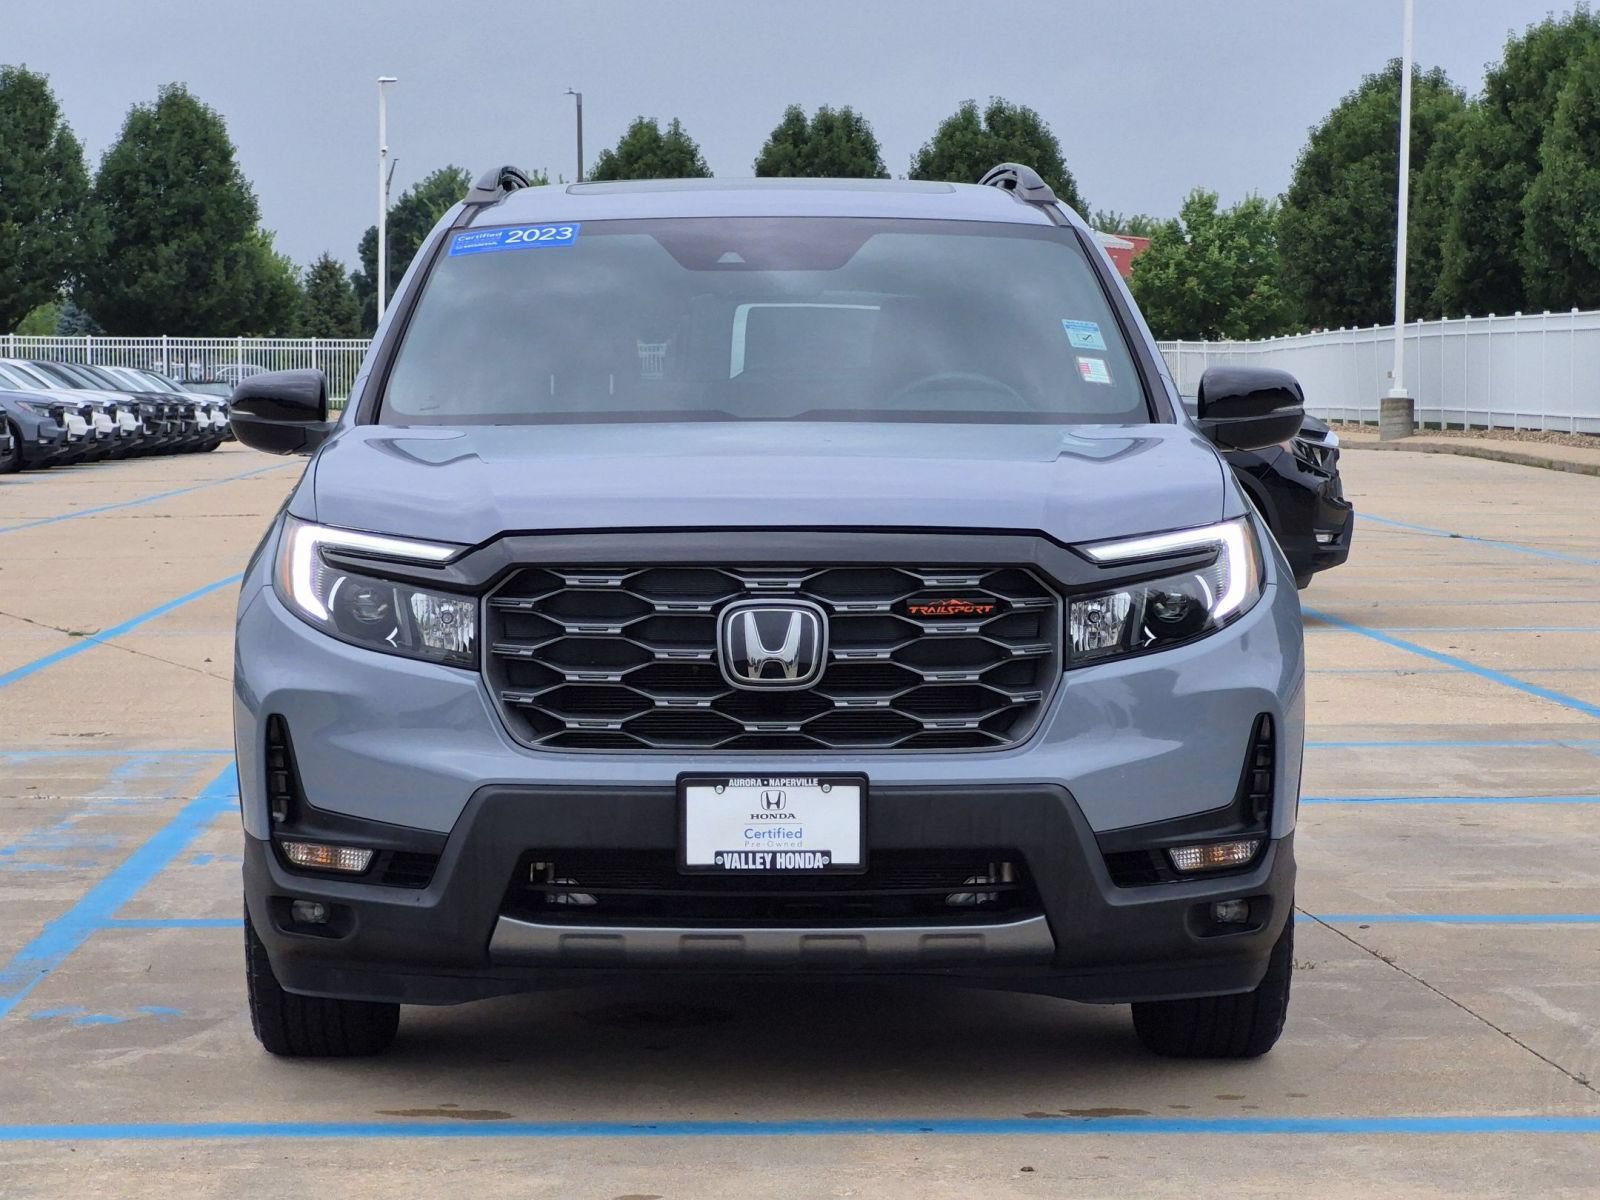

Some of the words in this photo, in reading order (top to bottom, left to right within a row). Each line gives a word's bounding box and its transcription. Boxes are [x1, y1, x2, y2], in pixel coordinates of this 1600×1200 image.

[504, 226, 574, 244] 2023
[909, 605, 994, 615] TRAILSPORT
[729, 778, 762, 787] AURORA
[769, 778, 819, 787] NAPERVILLE
[744, 827, 803, 839] Certified
[744, 840, 803, 848] Pre-Owned
[723, 852, 773, 870] VALLEY
[776, 852, 824, 869] HONDA
